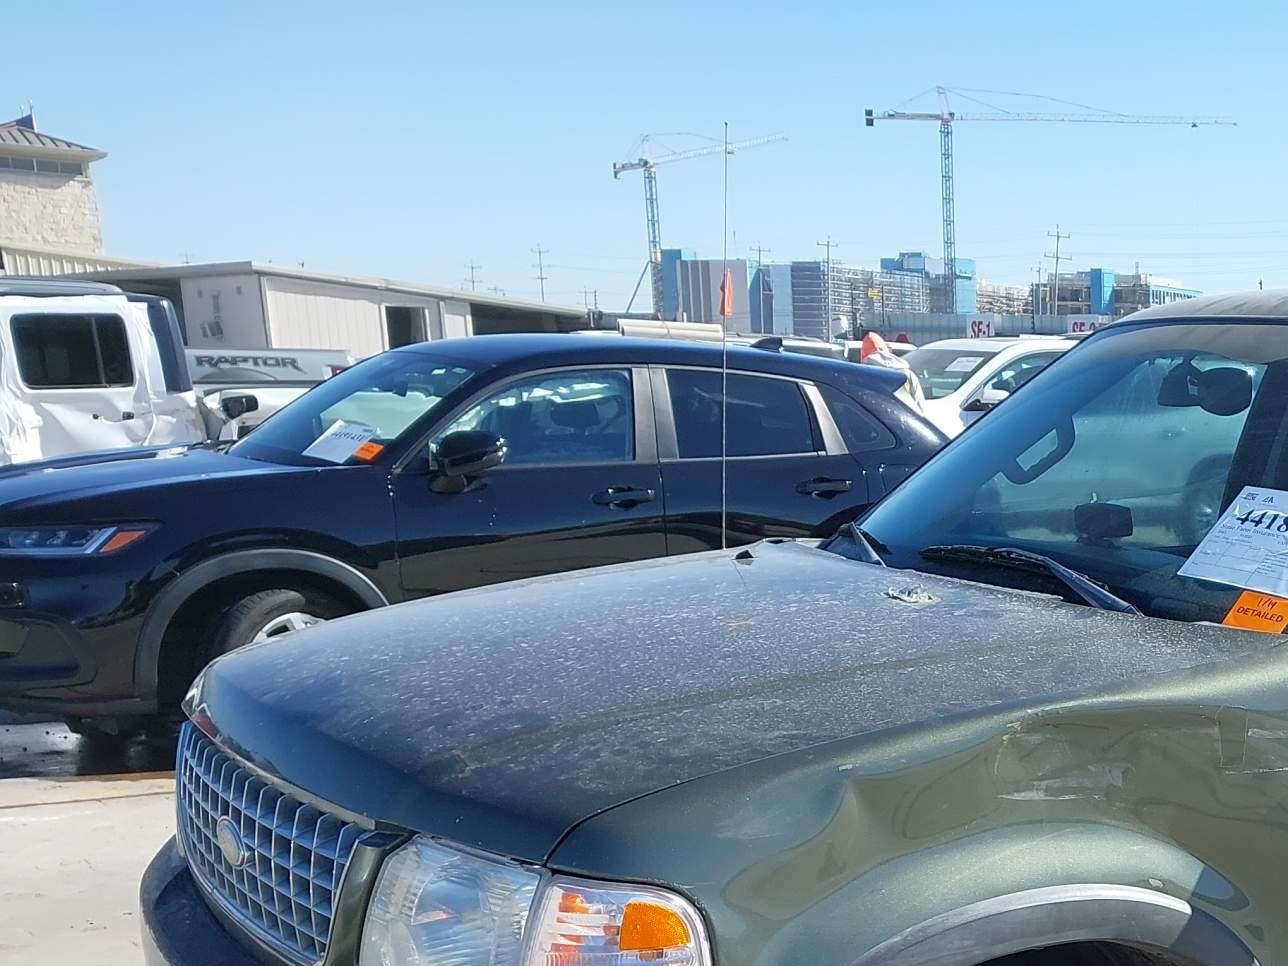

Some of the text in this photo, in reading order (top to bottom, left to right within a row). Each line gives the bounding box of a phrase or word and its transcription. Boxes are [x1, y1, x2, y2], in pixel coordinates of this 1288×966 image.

[970, 320, 991, 339] SF-1
[194, 355, 308, 375] RAPTOR
[1236, 606, 1284, 623] DETAILED
